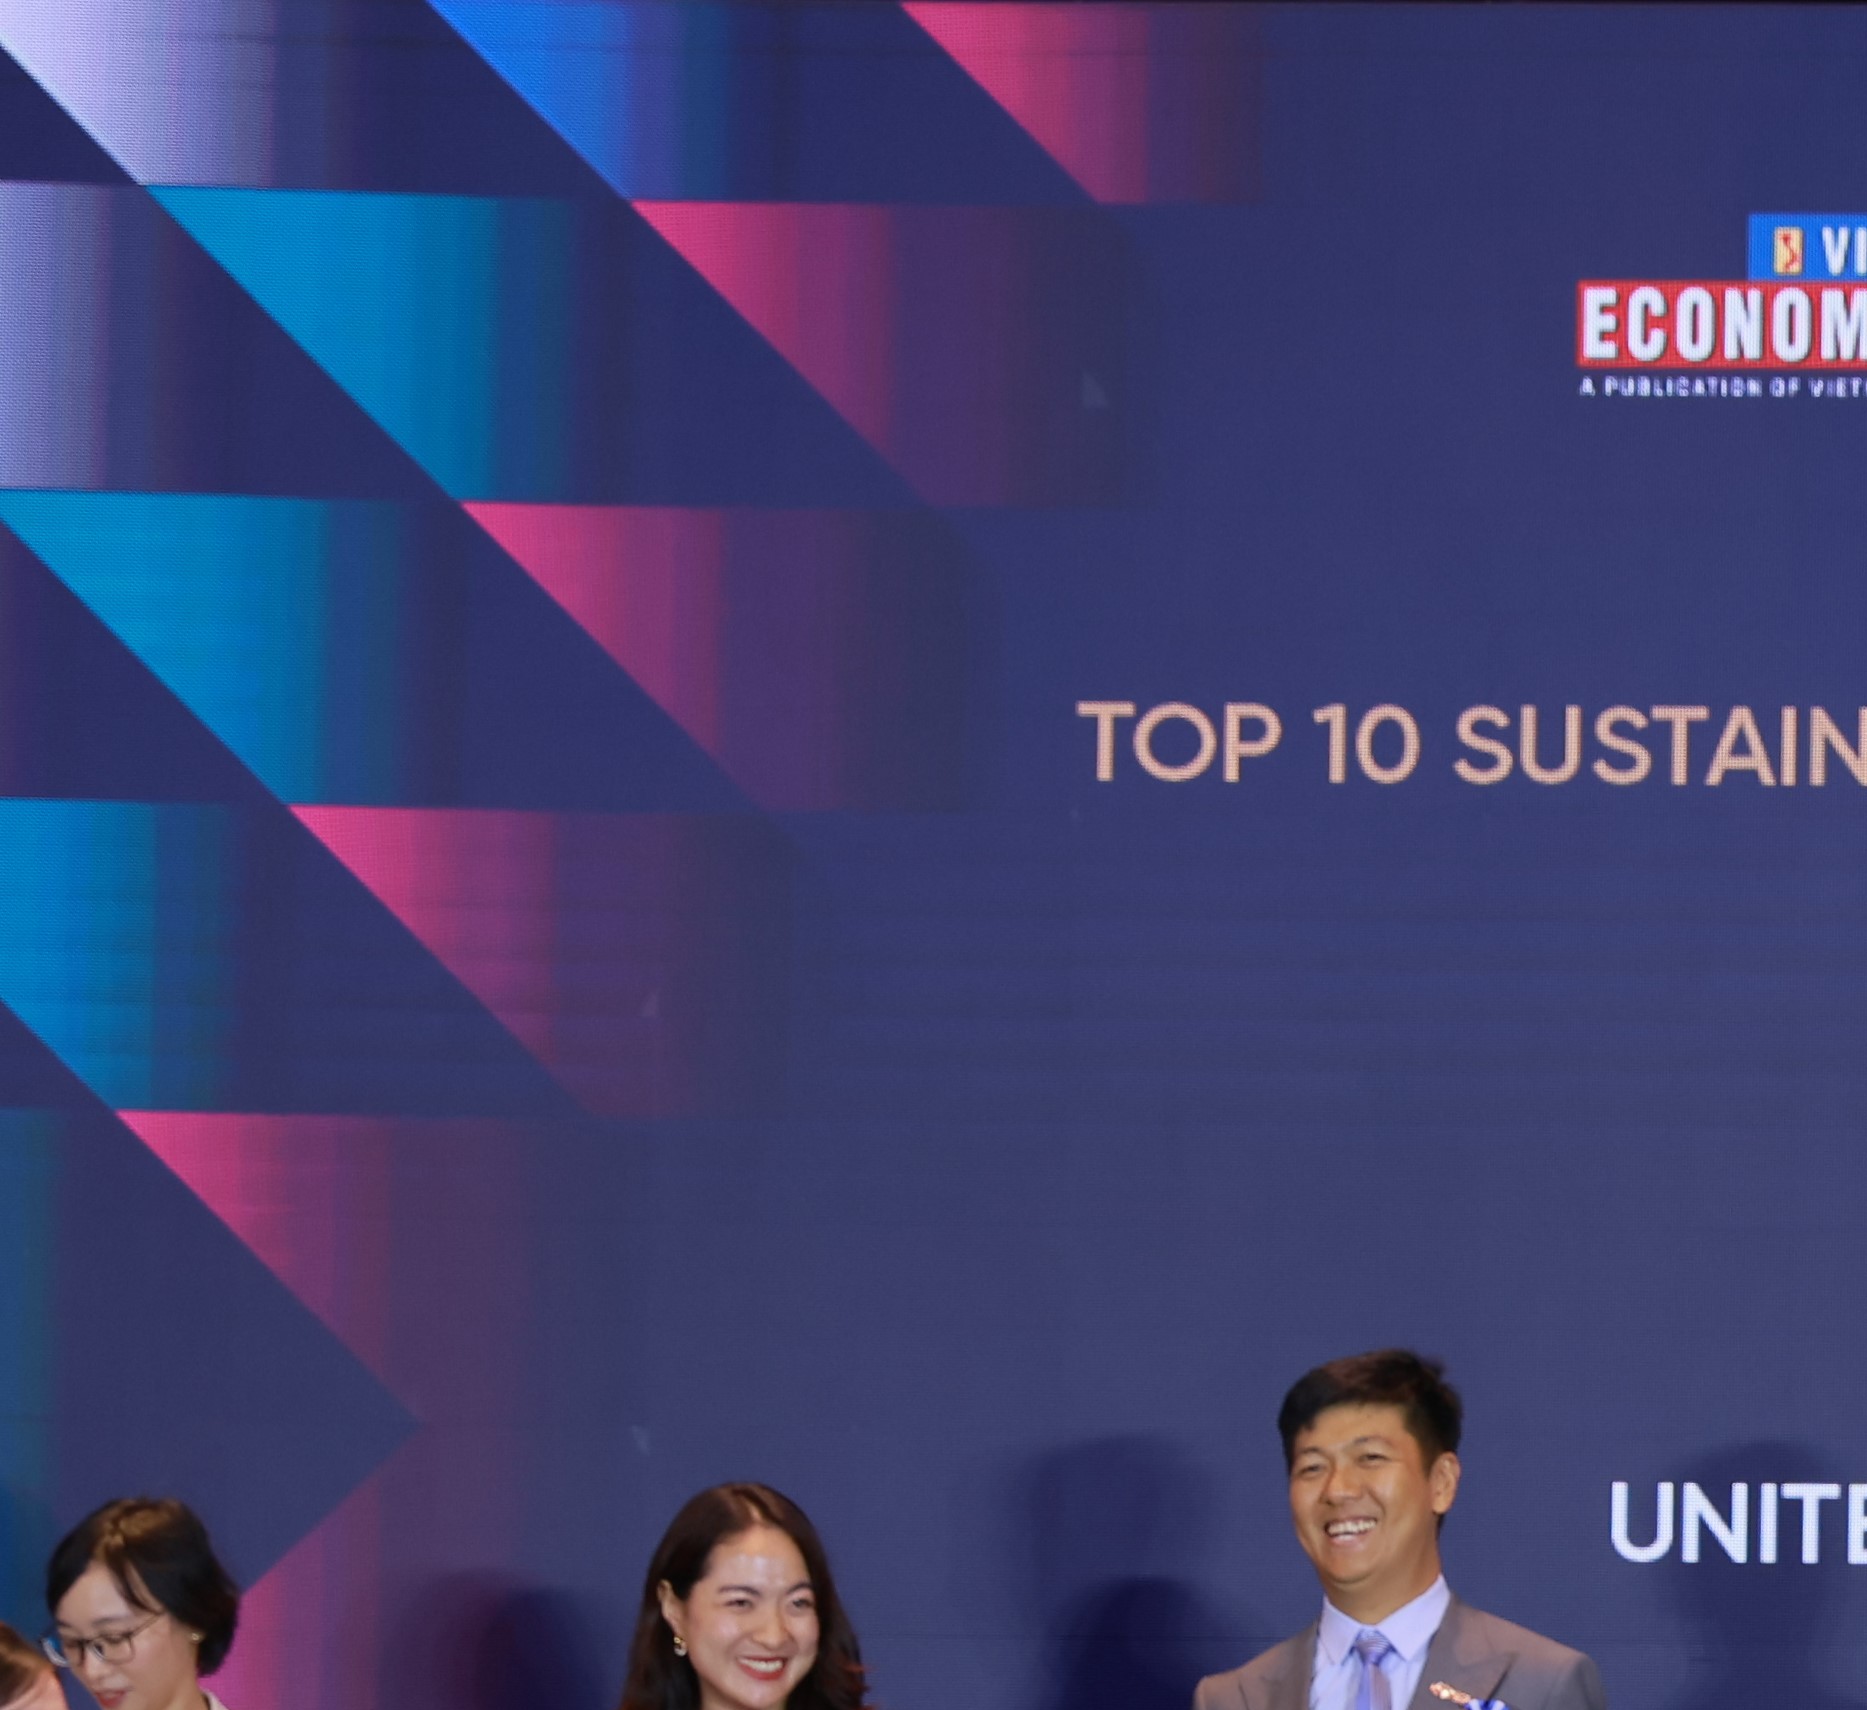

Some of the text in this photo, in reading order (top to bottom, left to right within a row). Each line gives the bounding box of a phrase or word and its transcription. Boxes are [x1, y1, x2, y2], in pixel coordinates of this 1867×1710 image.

[1580, 377, 1596, 396] A
[1604, 376, 1762, 398] PUBLICATION
[1771, 377, 1799, 398] OF
[1076, 701, 1282, 783] TOP
[1313, 703, 1421, 784] 10
